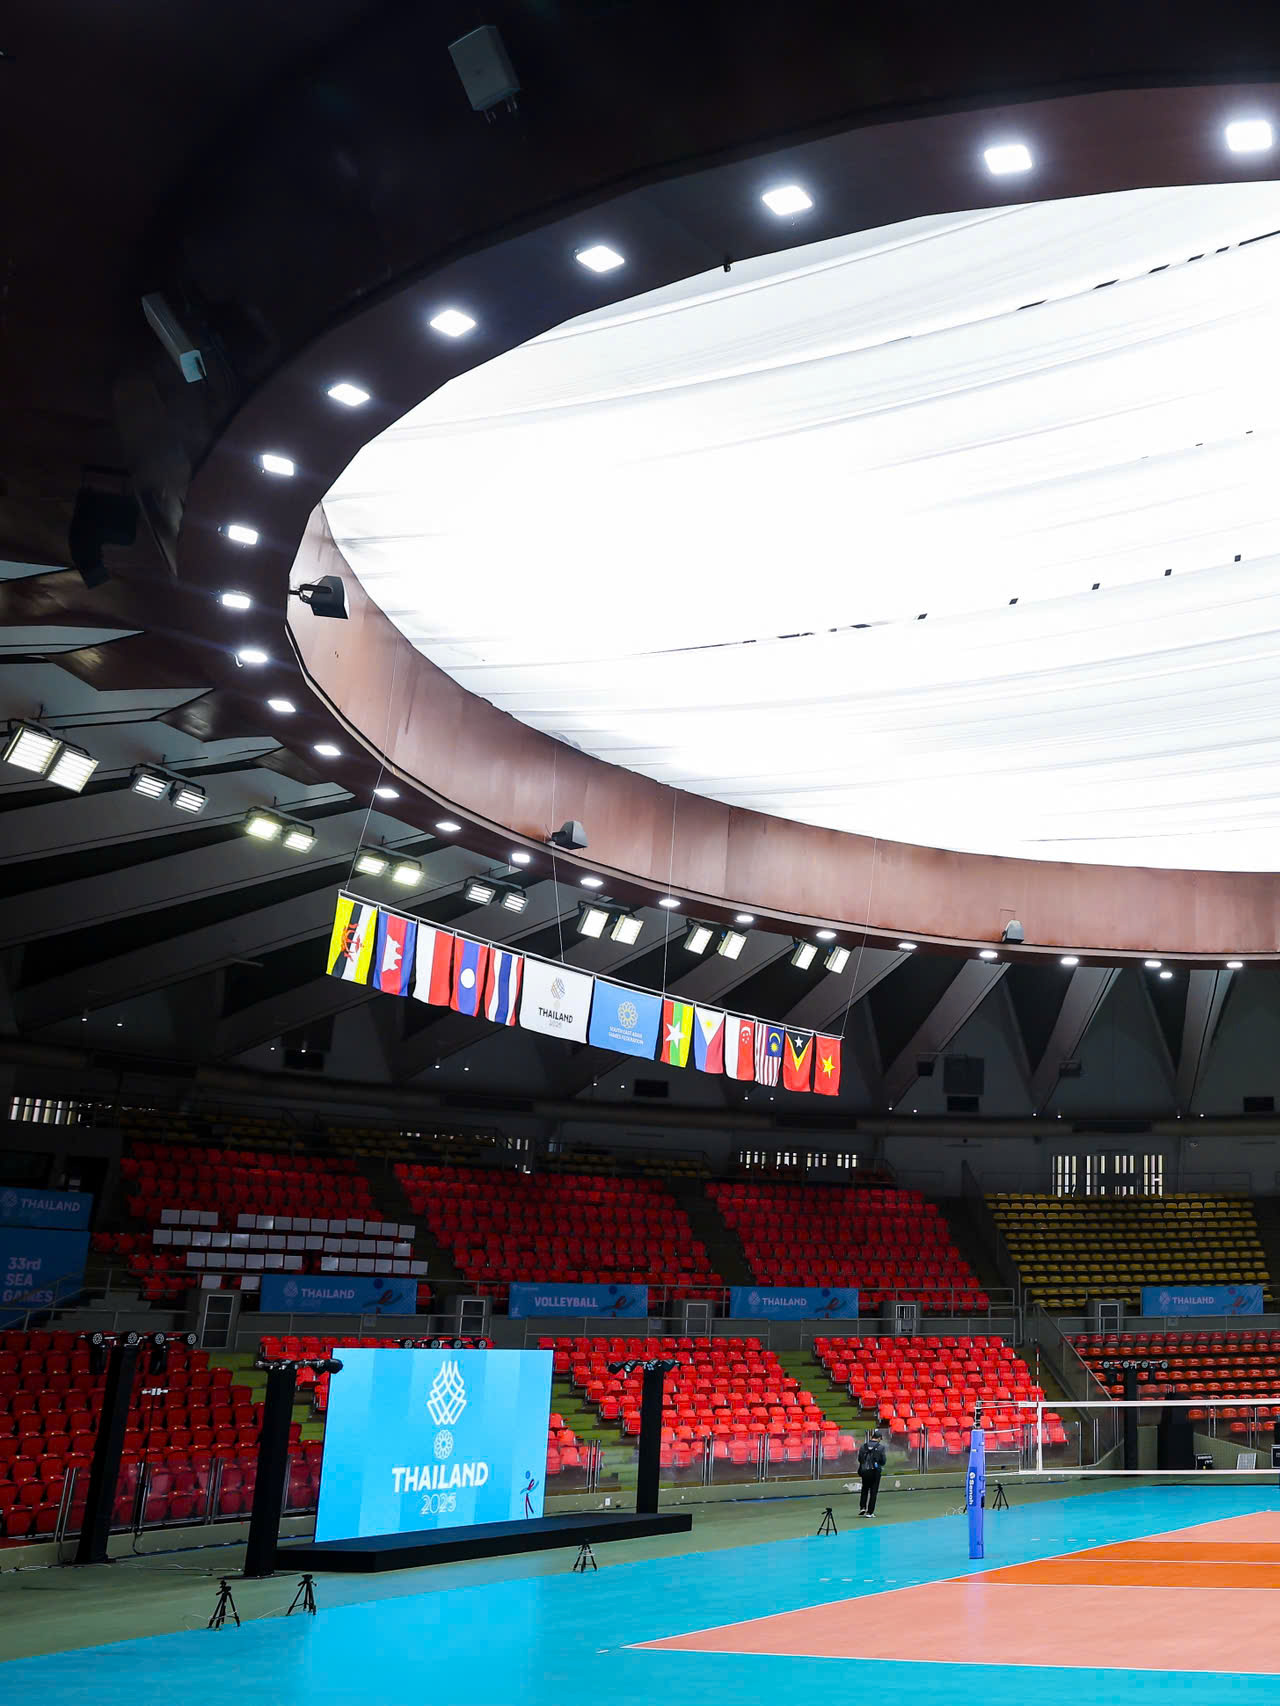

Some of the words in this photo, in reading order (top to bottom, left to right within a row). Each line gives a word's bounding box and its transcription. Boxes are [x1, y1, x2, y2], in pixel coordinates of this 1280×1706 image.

[538, 1006, 574, 1024] THAILAND
[21, 1198, 81, 1212] THAILAND
[8, 1257, 42, 1271] 33rd
[5, 1273, 33, 1287] SEA
[301, 1288, 355, 1299] THAILAND
[1172, 1296, 1215, 1305] THAILAND
[534, 1296, 599, 1308] VOLLEYBALL
[761, 1297, 807, 1306] THAILAND
[391, 1461, 489, 1493] THAILAND
[419, 1492, 457, 1515] 2025
